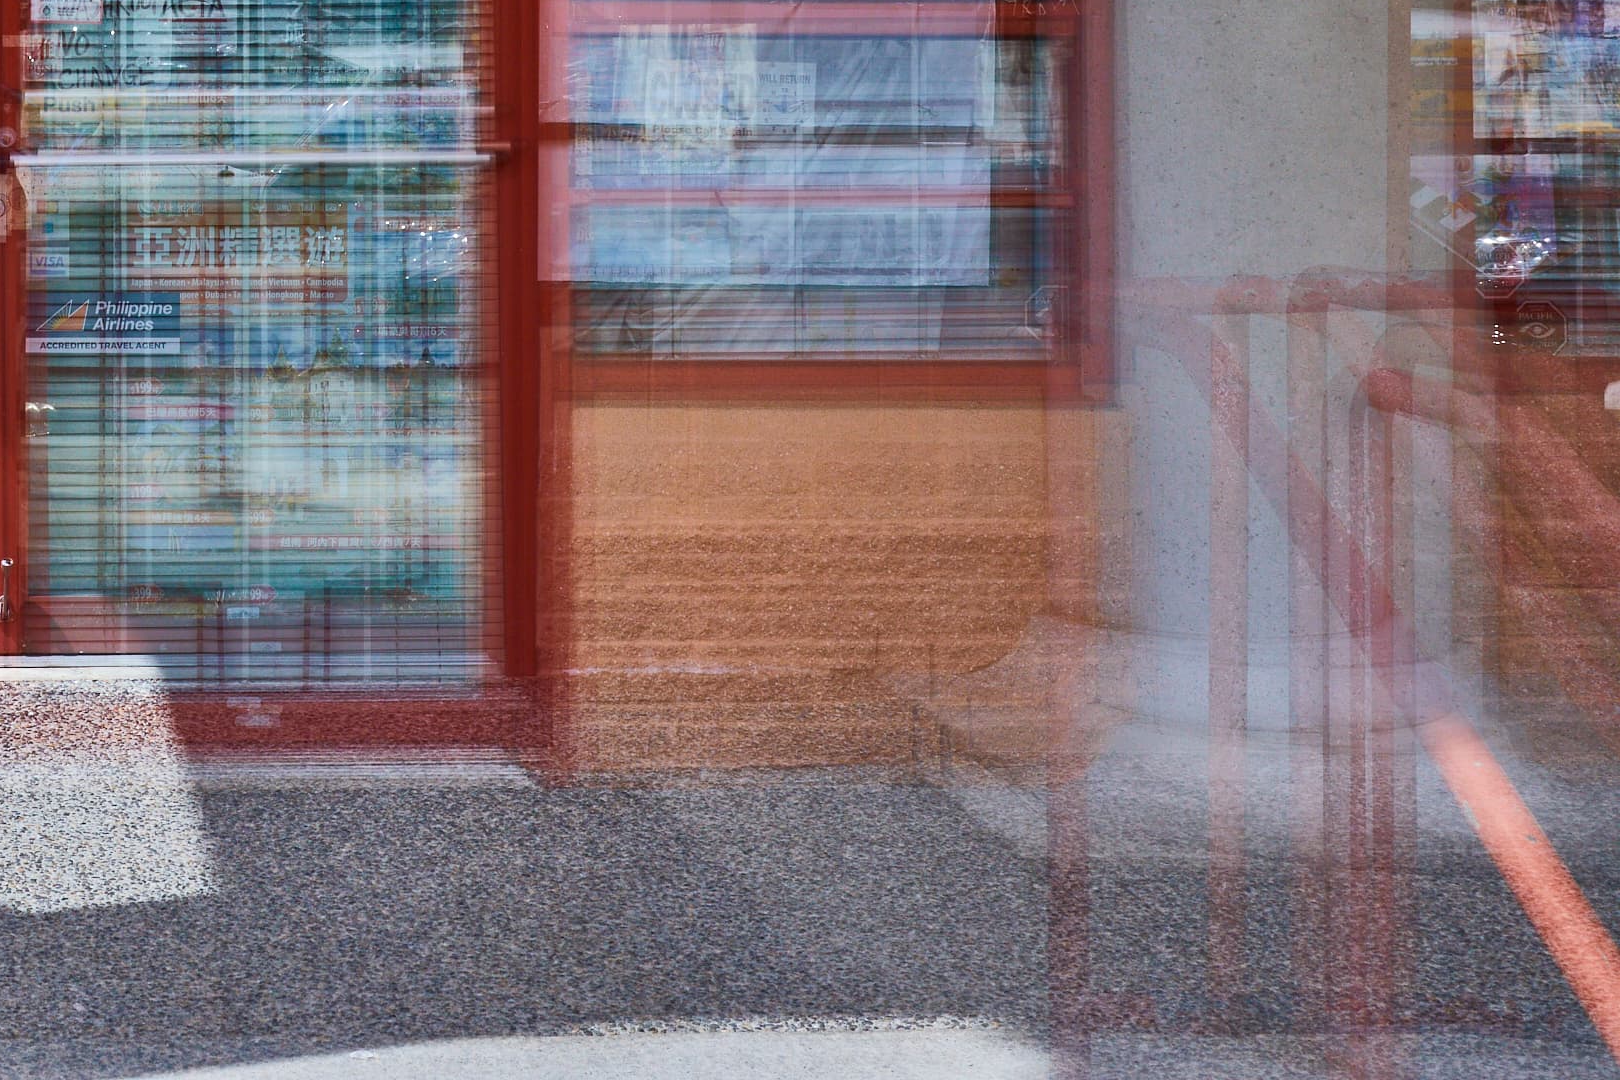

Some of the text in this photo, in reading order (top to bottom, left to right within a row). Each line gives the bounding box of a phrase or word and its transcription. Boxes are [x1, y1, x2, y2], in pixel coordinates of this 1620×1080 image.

[44, 96, 96, 112] Push
[132, 225, 348, 269] 亞洲精選遊
[35, 256, 65, 268] VISA
[131, 279, 153, 289] Japan
[159, 278, 186, 287] Korean
[191, 277, 225, 288] Malaysia
[269, 278, 301, 286] Vietnam
[306, 278, 345, 287] Cambodia
[205, 291, 228, 299] Dubai
[94, 300, 173, 317] Philippine
[92, 318, 155, 331] Airlines
[40, 342, 167, 350] ACCREDITED TRAVEL AGENT
